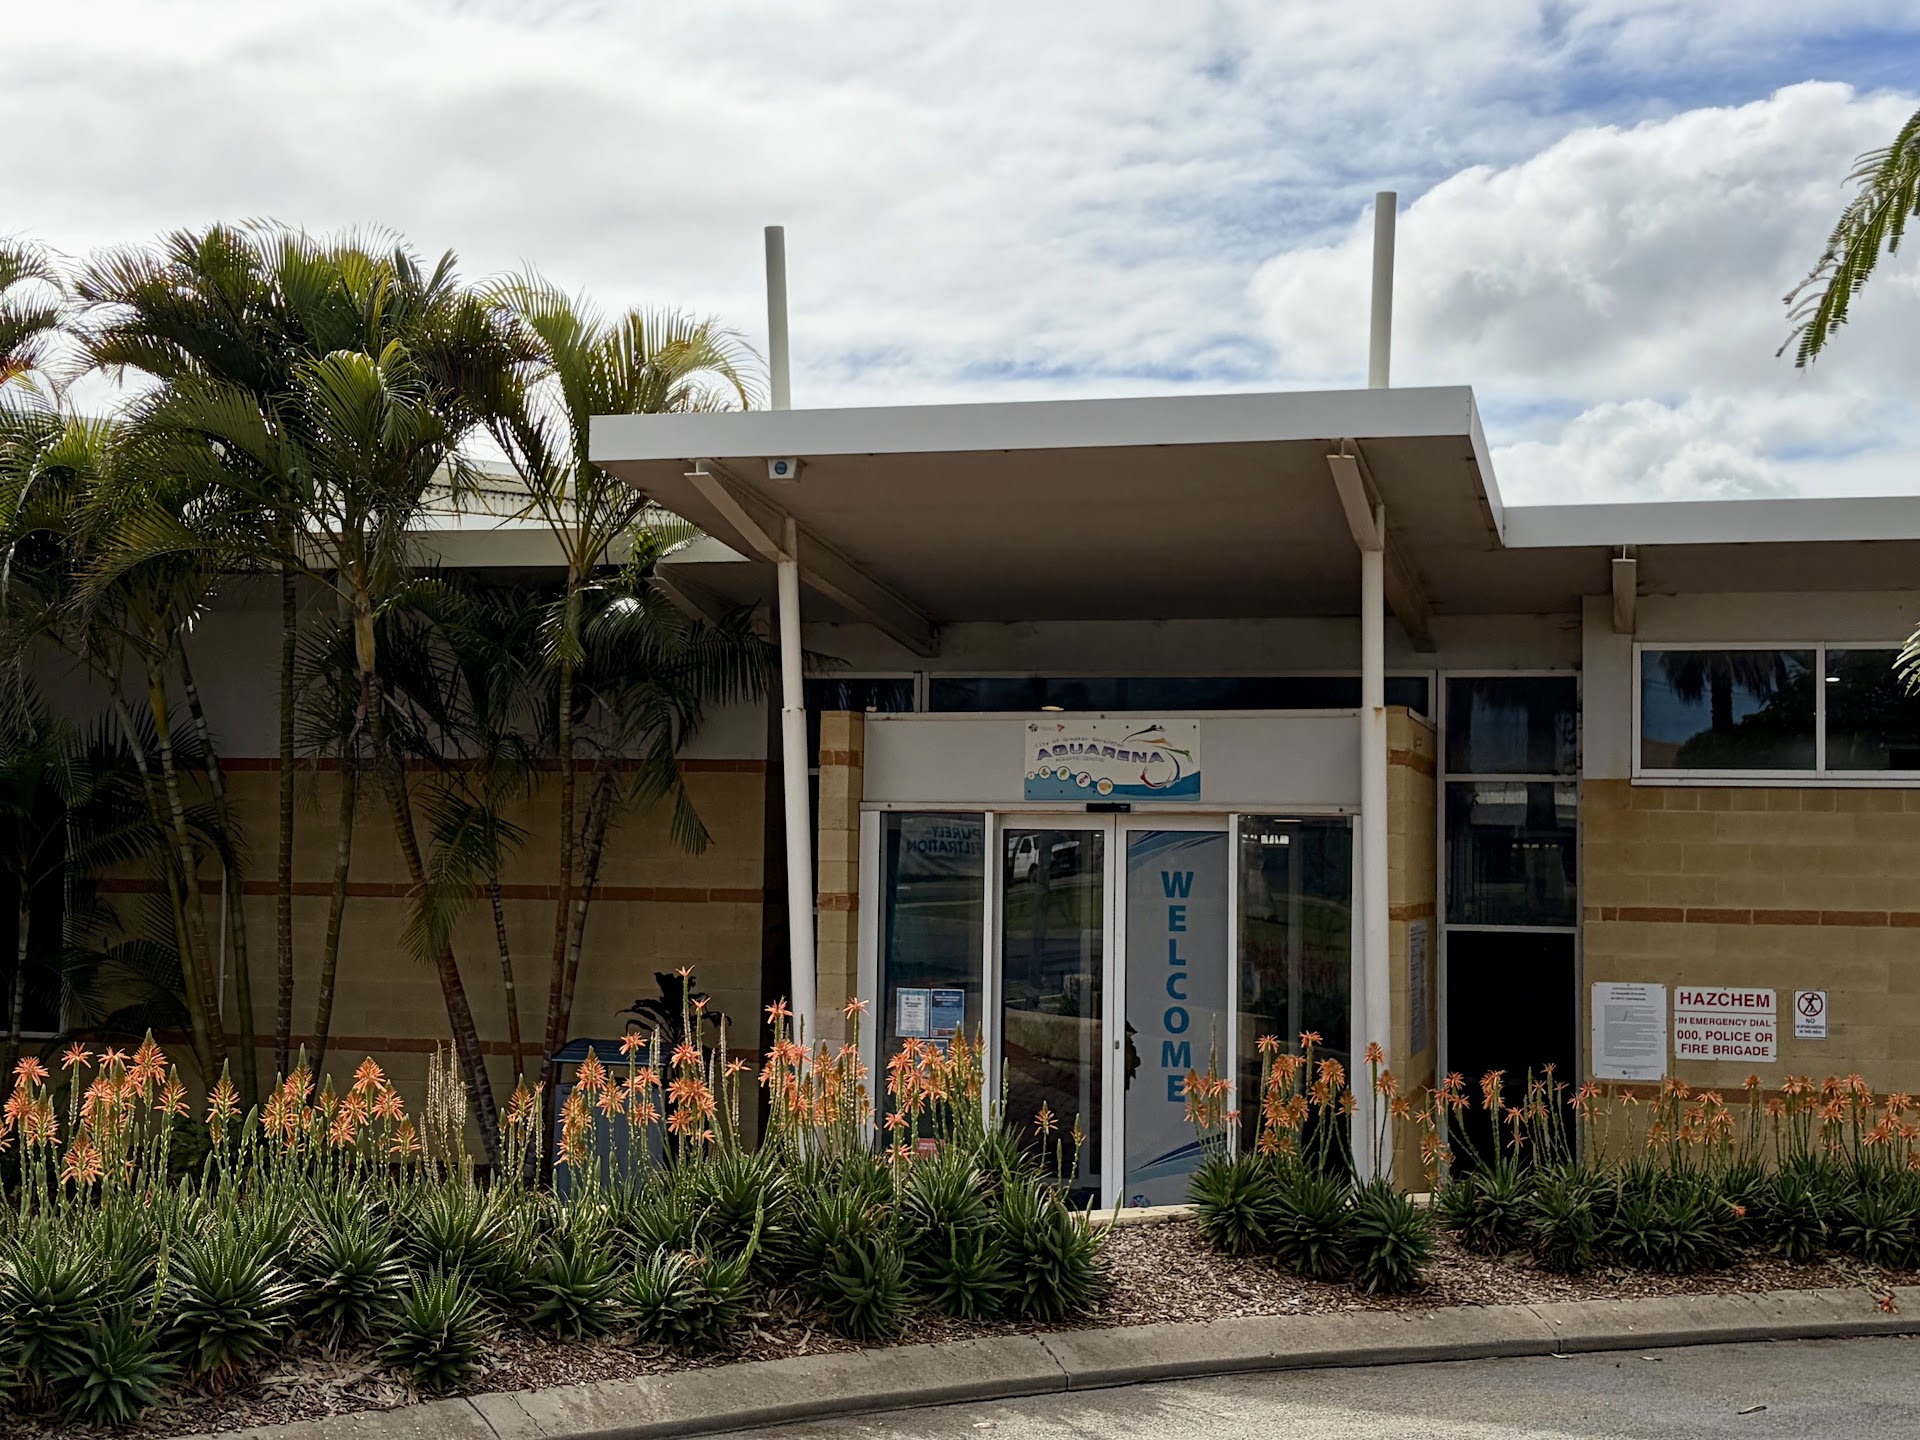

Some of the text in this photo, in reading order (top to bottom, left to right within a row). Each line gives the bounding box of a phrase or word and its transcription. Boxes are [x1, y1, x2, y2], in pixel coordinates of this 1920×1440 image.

[1037, 743, 1165, 763] AQUARENA
[1161, 871, 1194, 1102] WELCOME
[1680, 992, 1770, 1008] HAZCHEM
[1689, 1017, 1747, 1026] EMERGENCY
[1749, 1019, 1772, 1027] DIAL
[1677, 1030, 1773, 1042] 000, POLICE OR
[1681, 1043, 1769, 1056] FIRE BRIGADE
